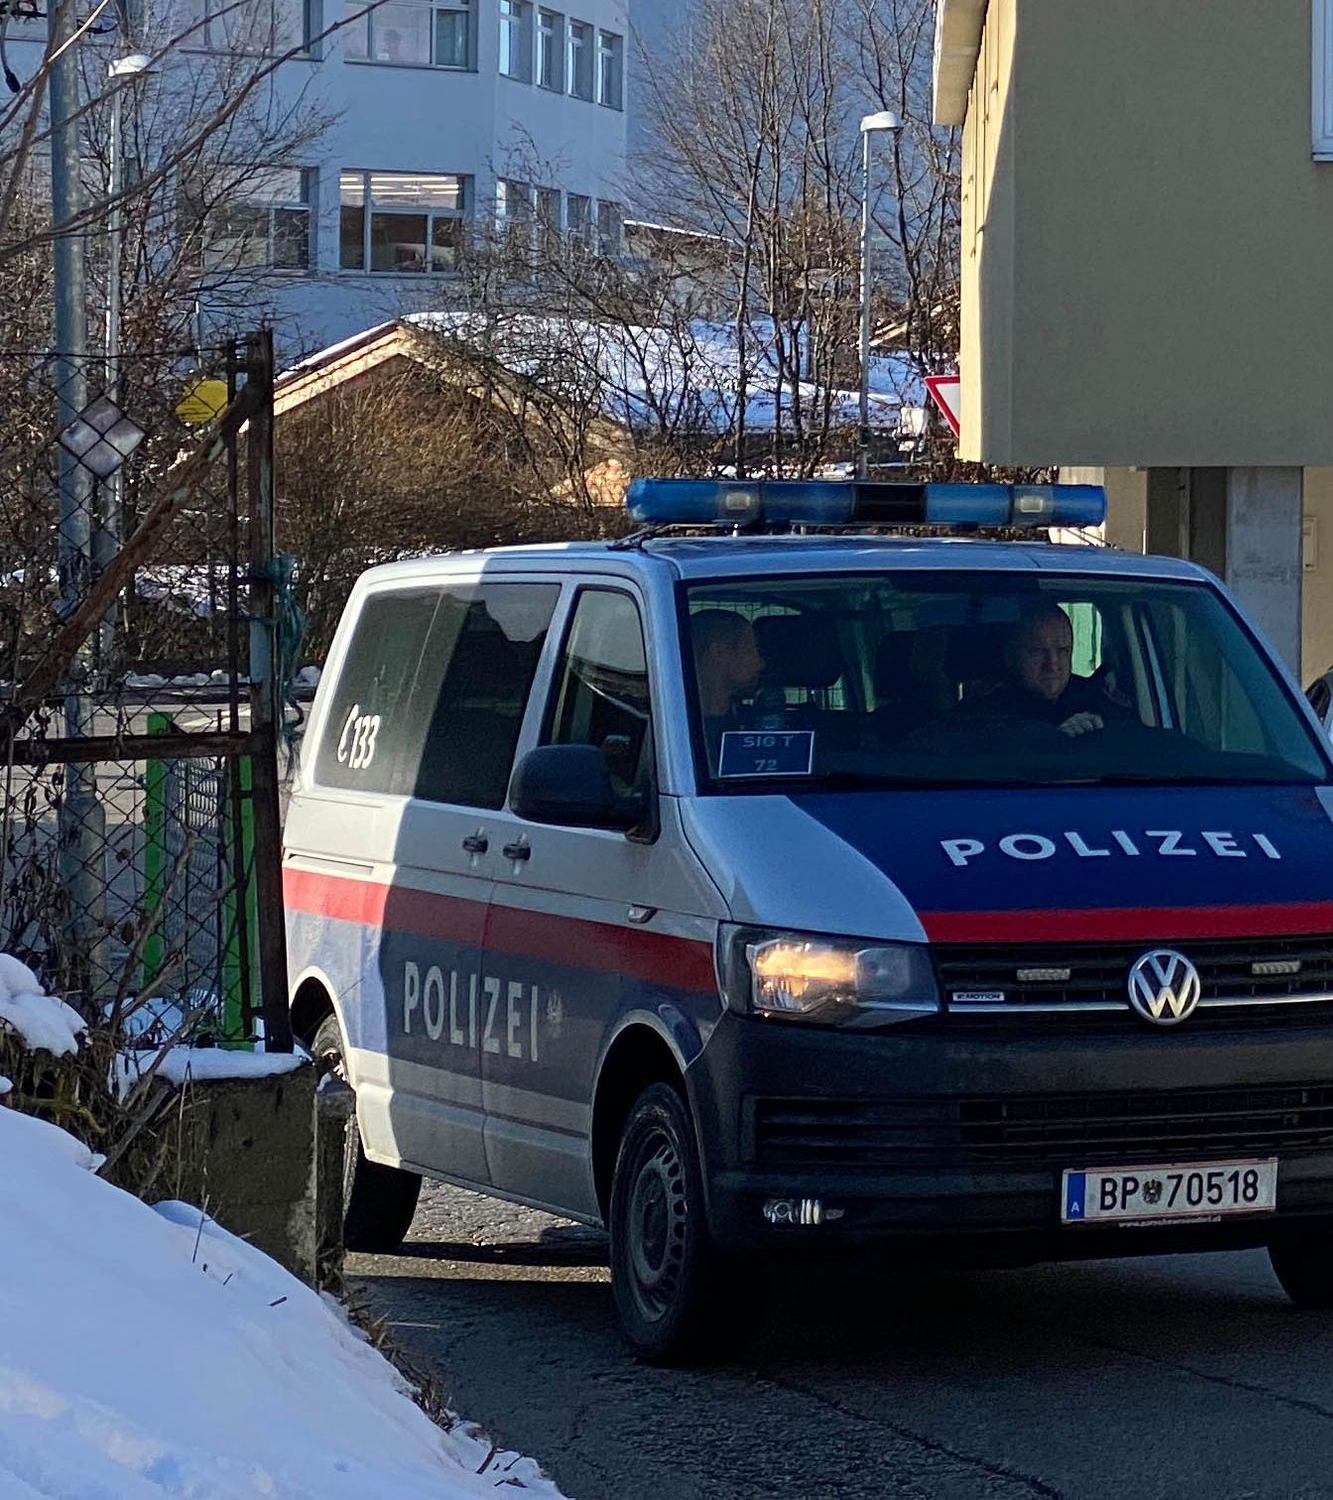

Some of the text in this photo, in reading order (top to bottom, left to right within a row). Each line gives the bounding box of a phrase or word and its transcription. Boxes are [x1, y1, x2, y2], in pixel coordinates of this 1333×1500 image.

[348, 714, 381, 769] 133
[939, 830, 1282, 867] POLIZEI
[403, 960, 539, 1063] POLIZEI
[1100, 1176, 1140, 1211] BP
[1166, 1169, 1259, 1208] 70518
